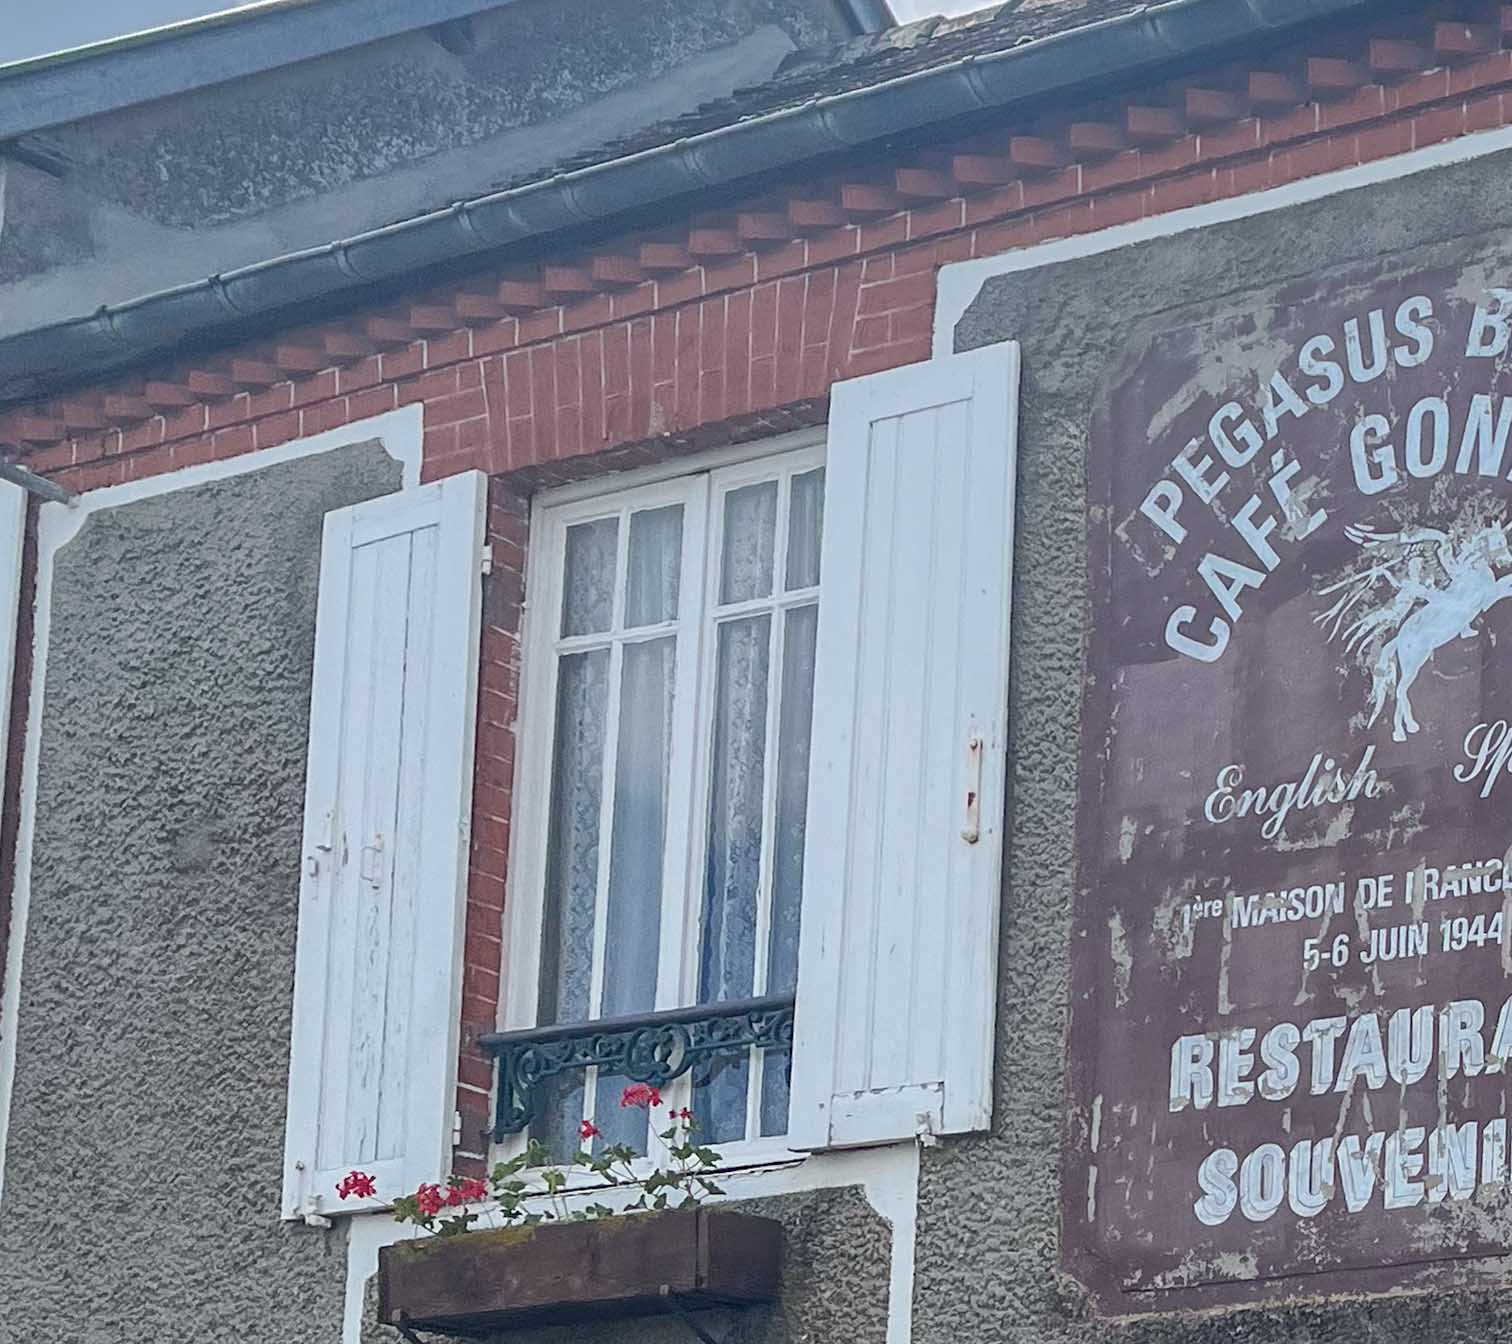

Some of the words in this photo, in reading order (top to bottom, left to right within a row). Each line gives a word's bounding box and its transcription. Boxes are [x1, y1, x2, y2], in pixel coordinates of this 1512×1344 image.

[1140, 296, 1434, 544] PEGASUS
[1165, 448, 1328, 663] CAFÉ
[1204, 745, 1380, 839] English
[1231, 882, 1345, 929] MAISON
[1358, 875, 1394, 909] DE
[1303, 933, 1350, 972] 5-6
[1360, 922, 1429, 964] JUIN
[1440, 912, 1504, 952] 1944
